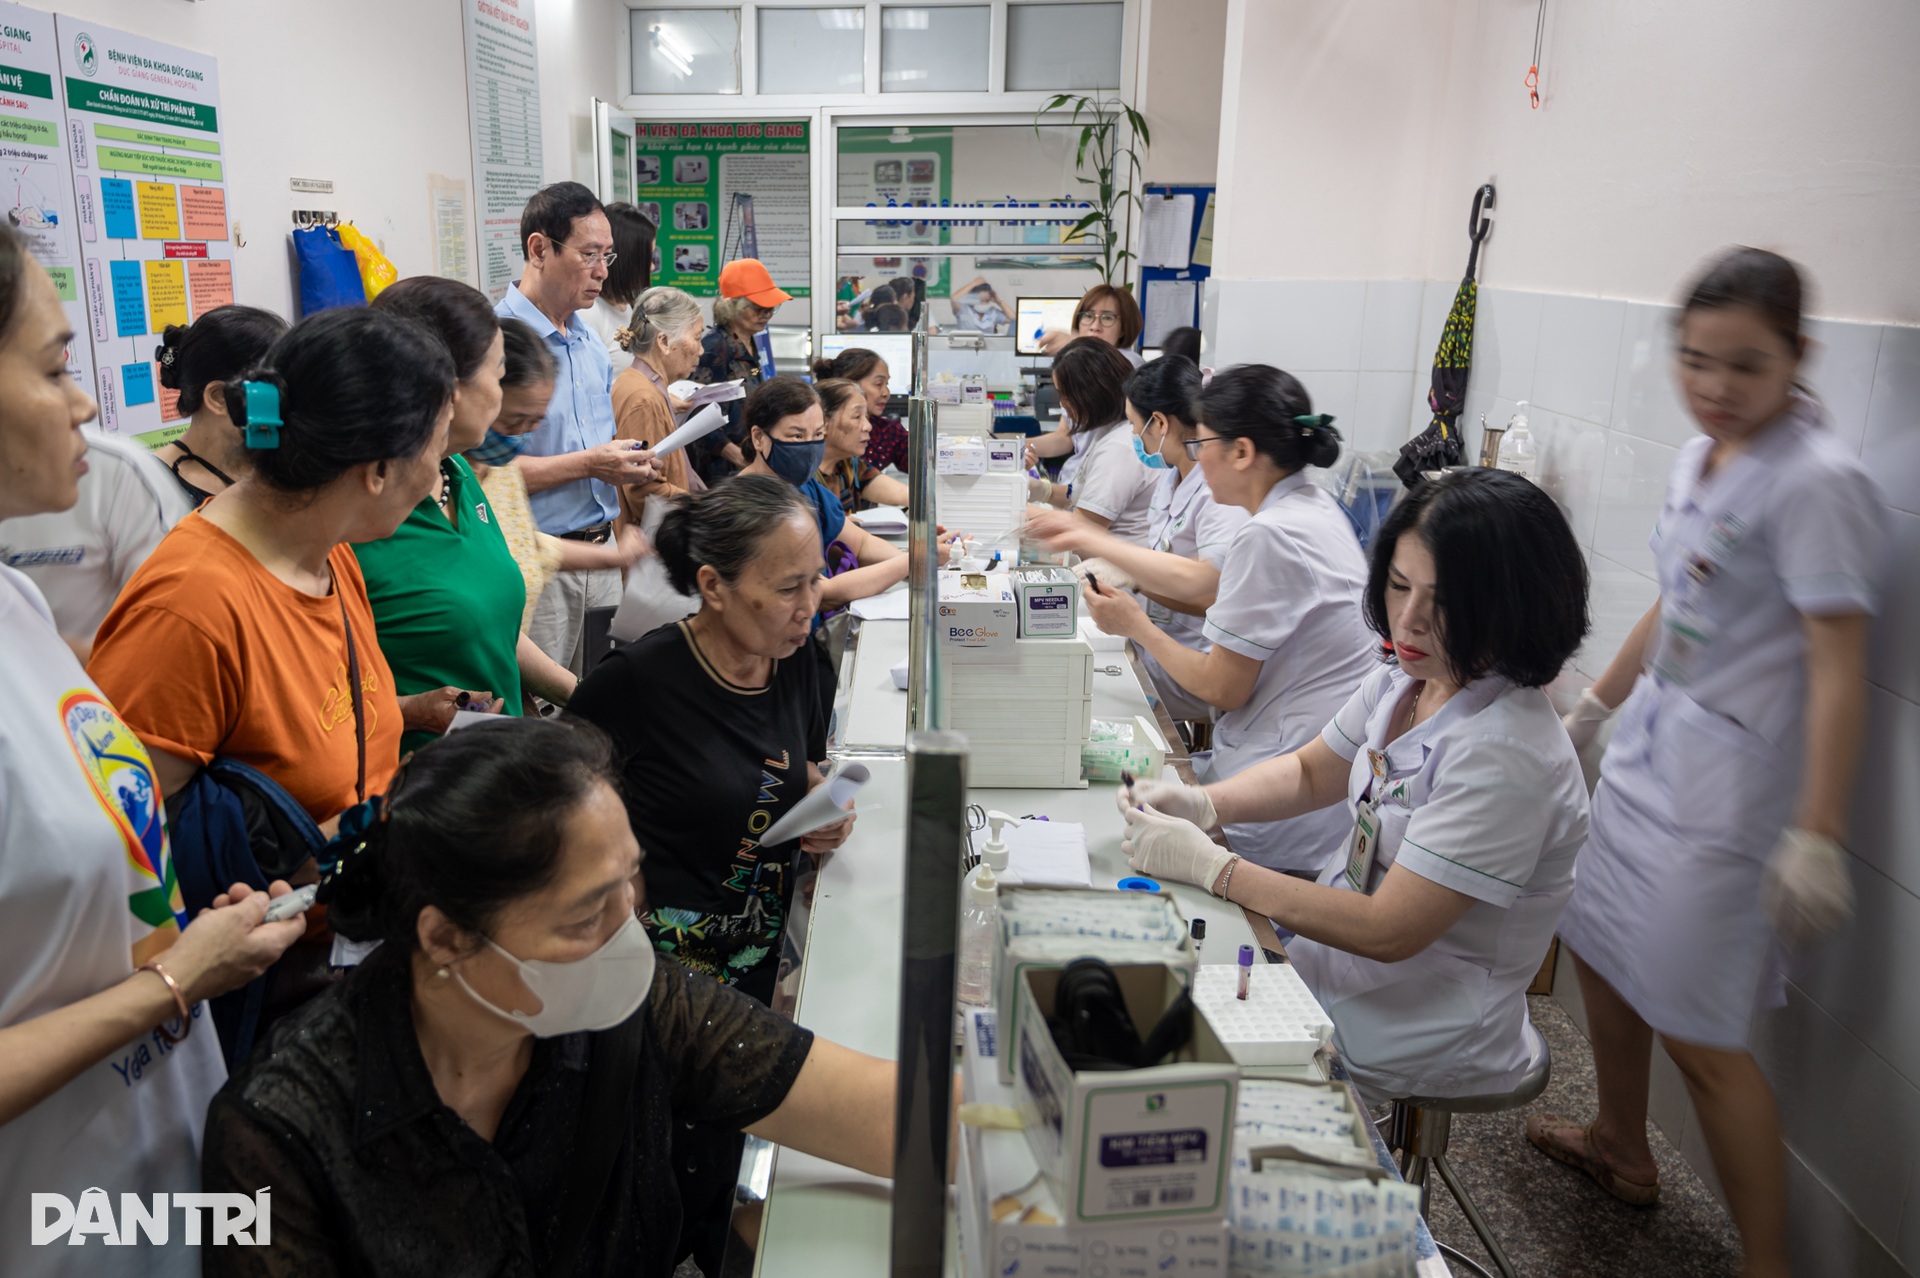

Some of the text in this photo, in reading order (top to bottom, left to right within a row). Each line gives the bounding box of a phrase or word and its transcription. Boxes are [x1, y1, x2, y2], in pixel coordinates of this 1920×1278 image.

[4, 26, 32, 42] GIANG
[108, 49, 204, 82] BỆNH VIỆN ĐA KHOA ĐỨC GIANG
[10, 74, 23, 90] VỆ
[118, 66, 198, 92] DUC GIANG GENERAL HOSPITAL
[120, 93, 140, 108] ĐOÁN
[140, 97, 149, 109] VÀ
[160, 102, 171, 113] TRÍ
[187, 106, 196, 119] VỆ
[650, 123, 678, 140] VIỆN
[681, 124, 697, 138] ĐA
[701, 124, 734, 138] KHOA
[737, 122, 761, 138] ĐỨC
[765, 124, 803, 138] GIANG
[75, 706, 98, 722] Day
